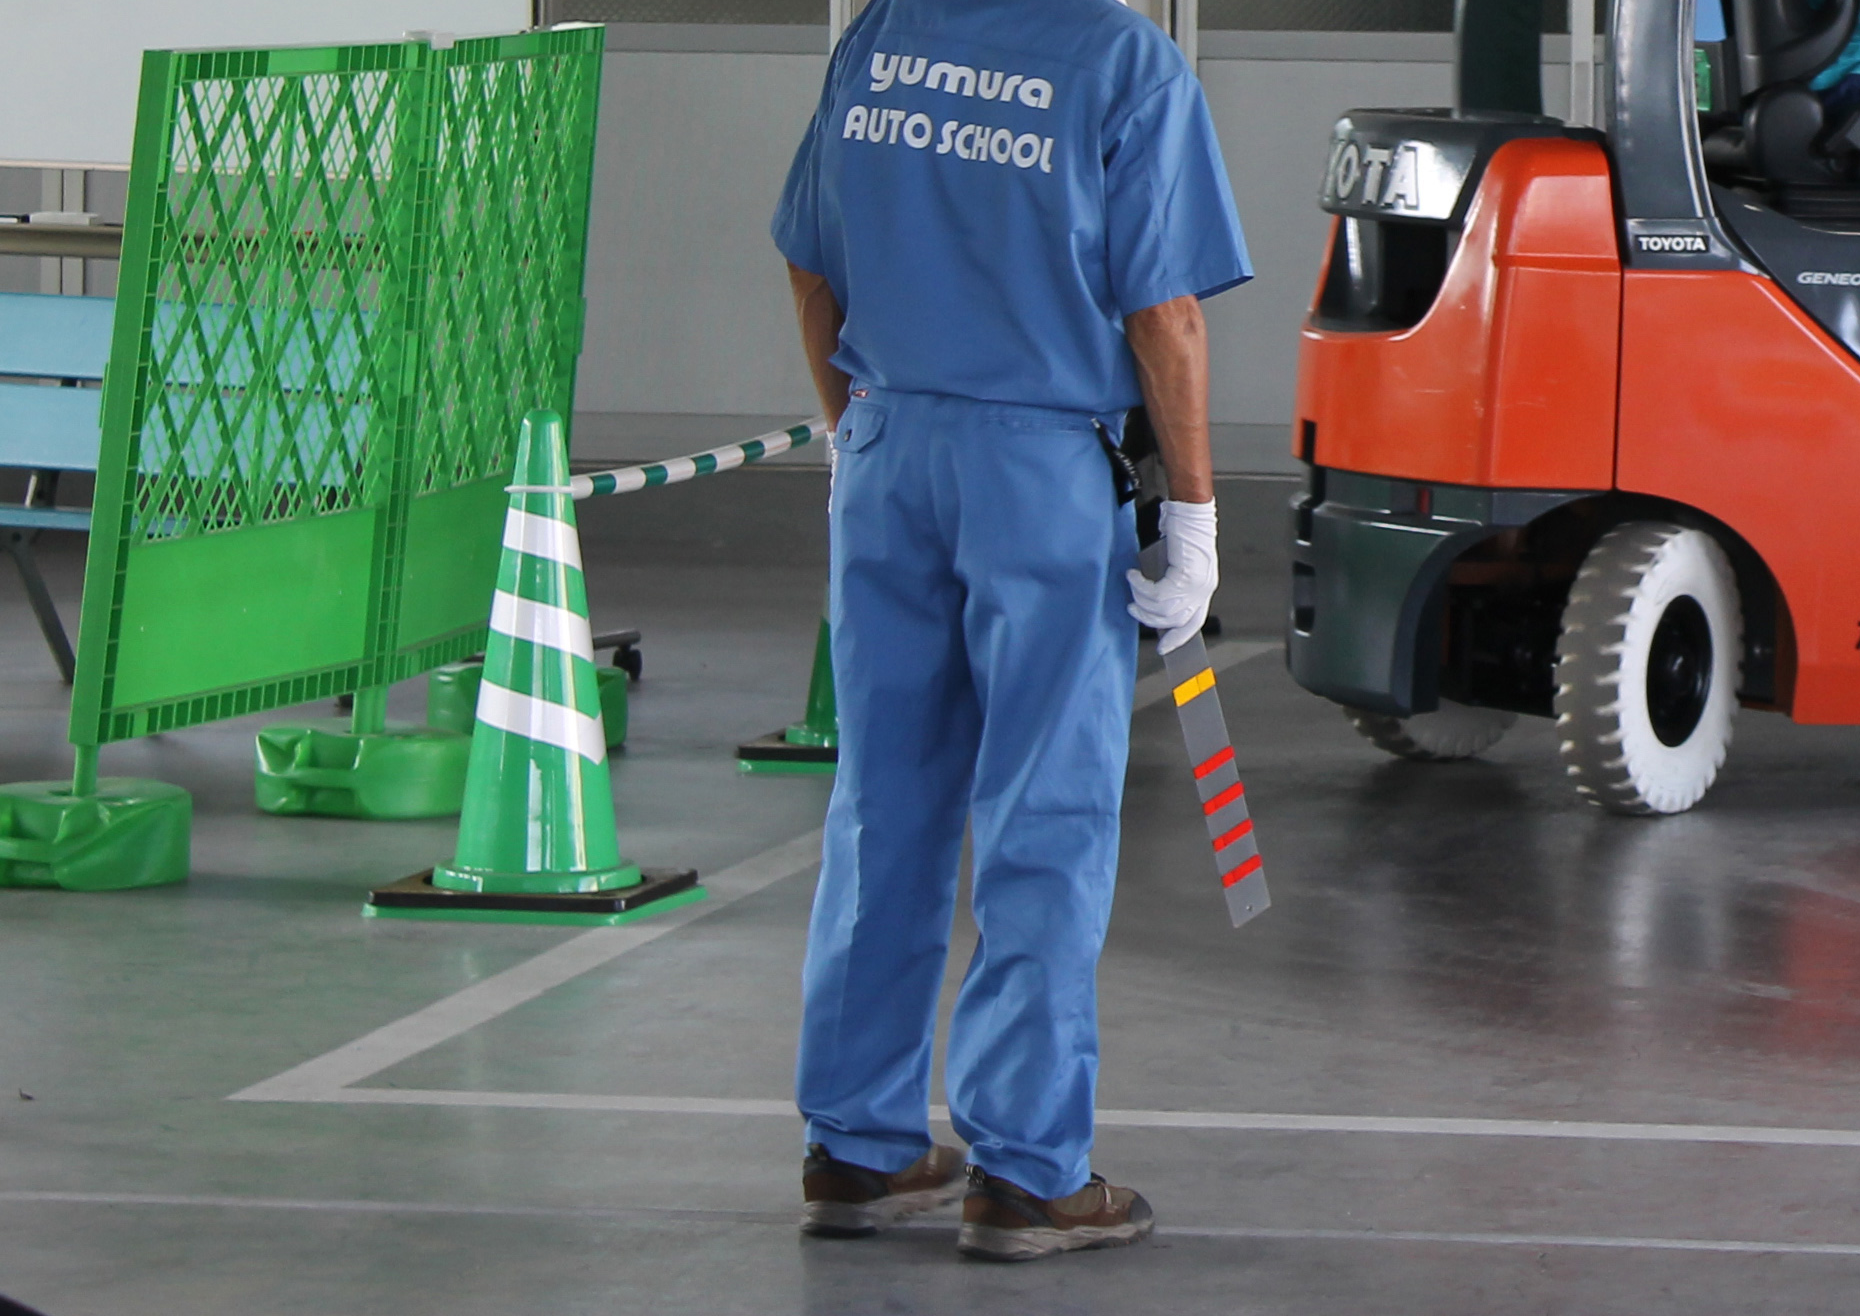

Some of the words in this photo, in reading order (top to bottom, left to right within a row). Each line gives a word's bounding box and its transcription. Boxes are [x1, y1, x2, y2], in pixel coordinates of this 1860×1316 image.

[870, 52, 1053, 109] yumura
[842, 105, 932, 149] AUTO
[936, 120, 1054, 173] SCHOOL
[1638, 236, 1706, 252] TOYOTA
